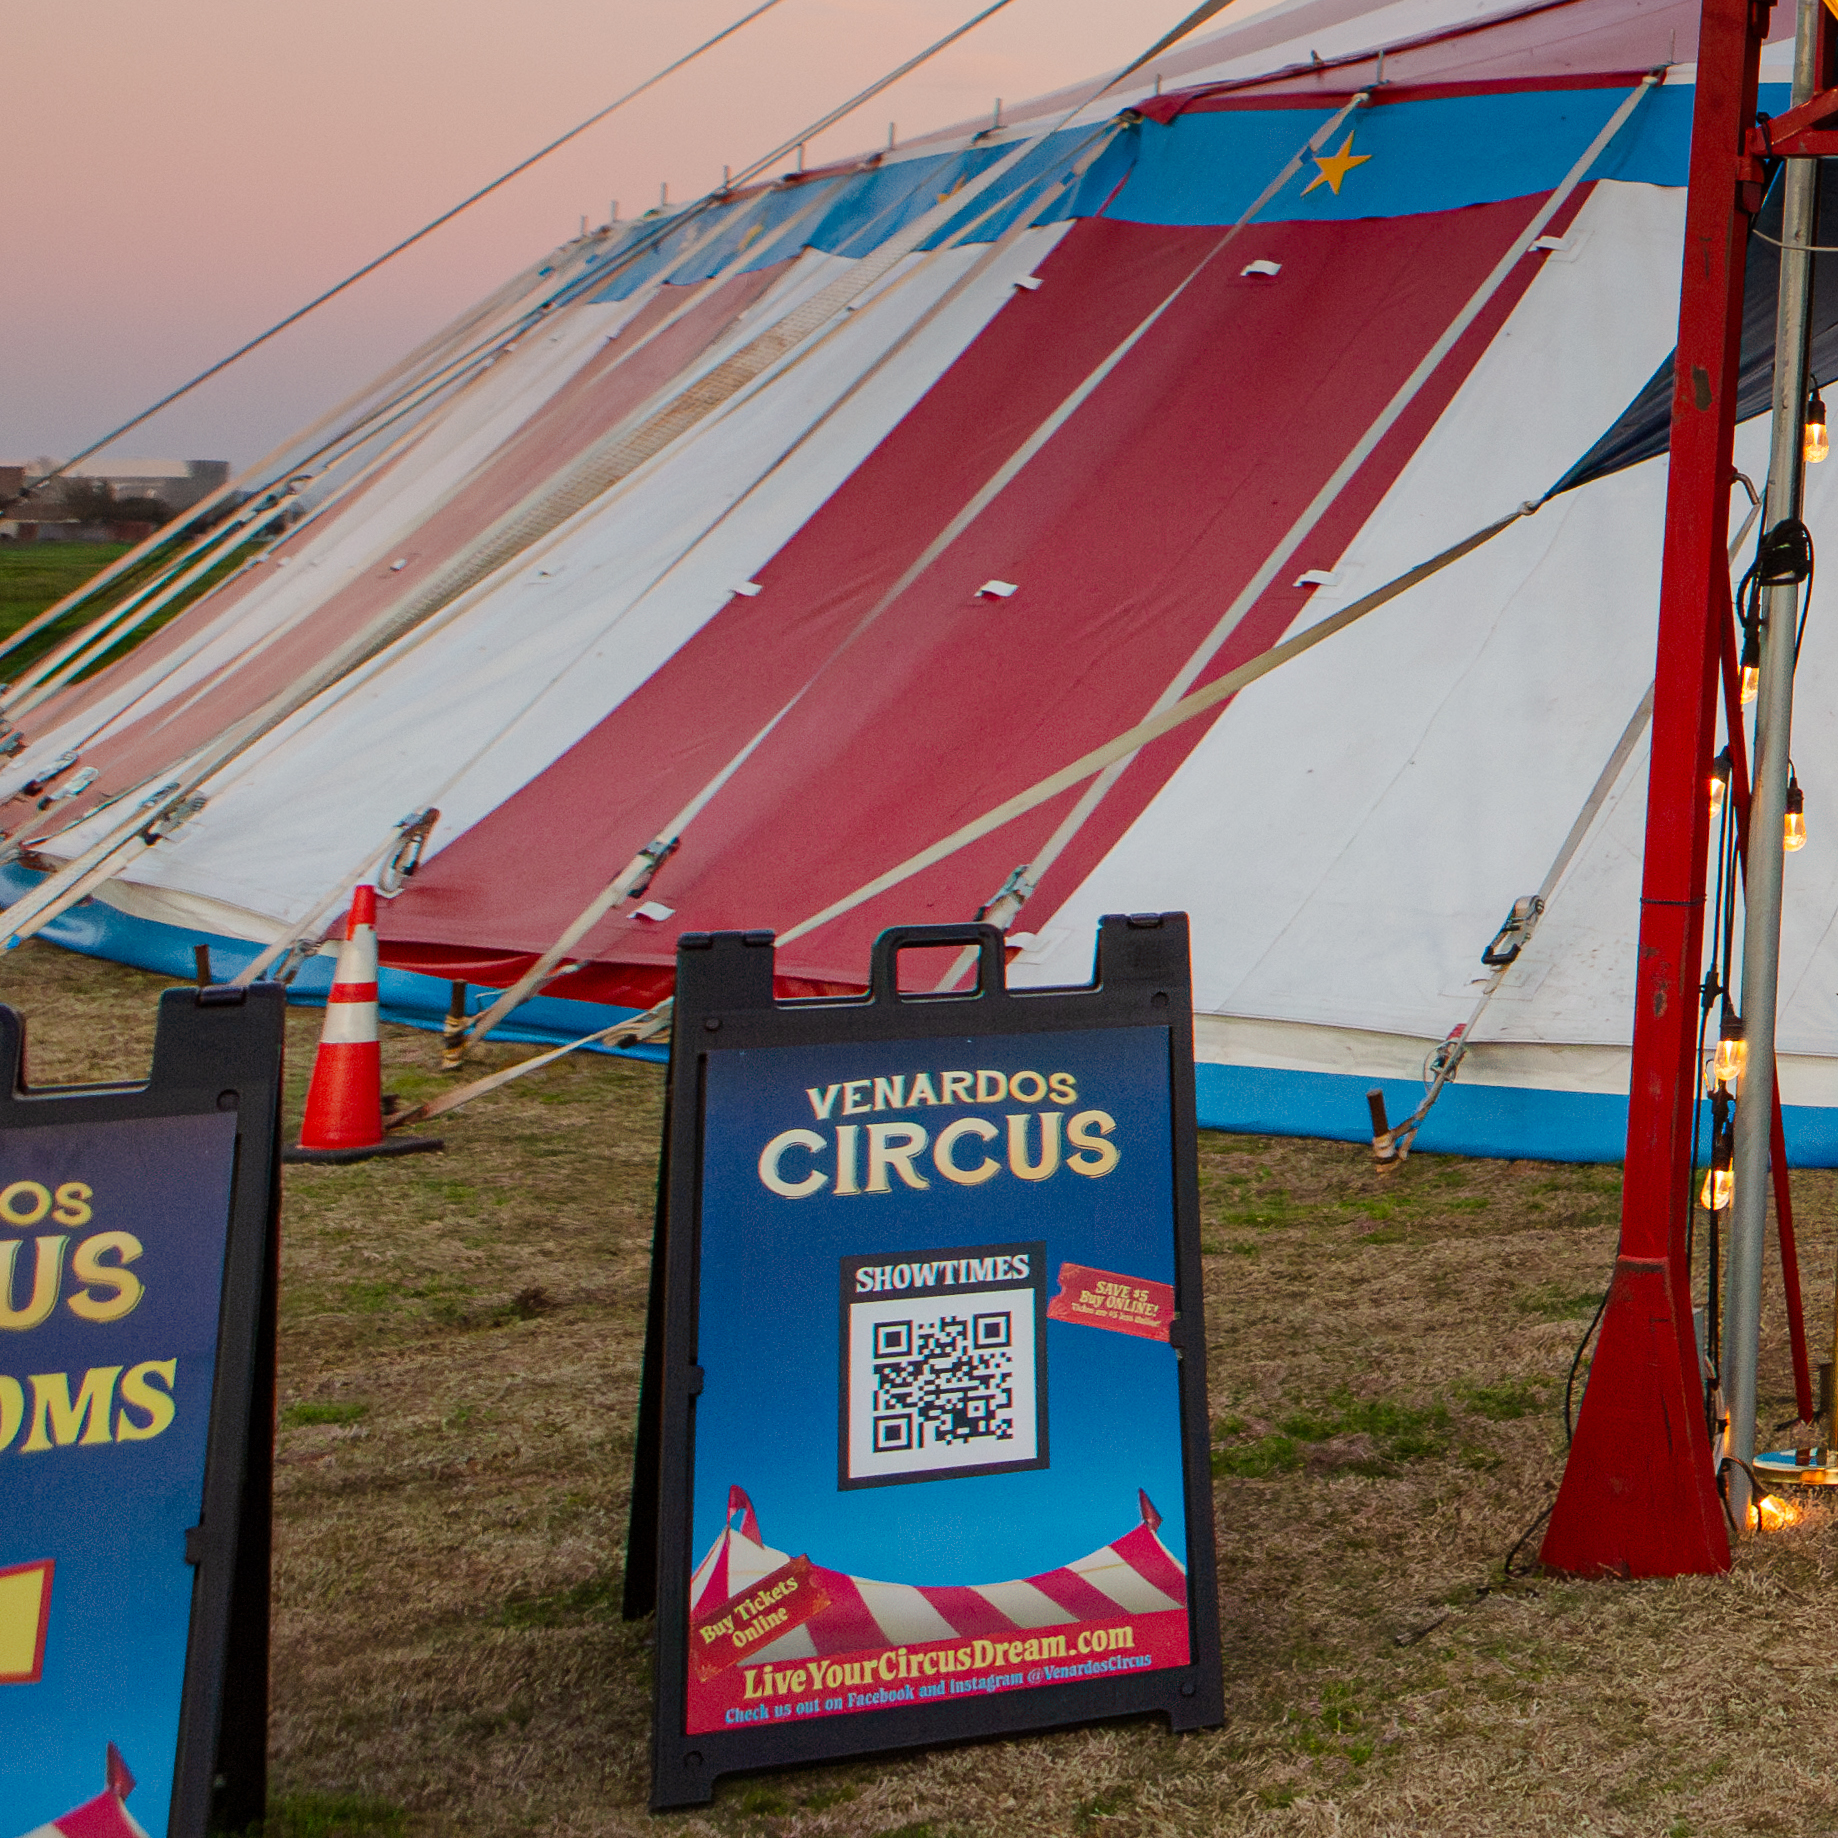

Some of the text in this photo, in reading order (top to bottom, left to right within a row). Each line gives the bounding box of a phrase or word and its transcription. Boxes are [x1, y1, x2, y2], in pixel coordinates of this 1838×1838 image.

[806, 1069, 1078, 1120] VENARDOS
[758, 1109, 1121, 1199] CIRCUS
[855, 1254, 1030, 1293] SHOWTIMES
[1096, 1281, 1149, 1303] SAVE $5
[1080, 1290, 1159, 1317] Buy ONLINE!
[700, 1577, 798, 1644] Buy Tickets
[732, 1607, 788, 1648] Online
[743, 1626, 1135, 1699] LiveYourCircusDream.com
[725, 1654, 1152, 1724] Check us out on Facebook and Instagram @VenardosCircus
